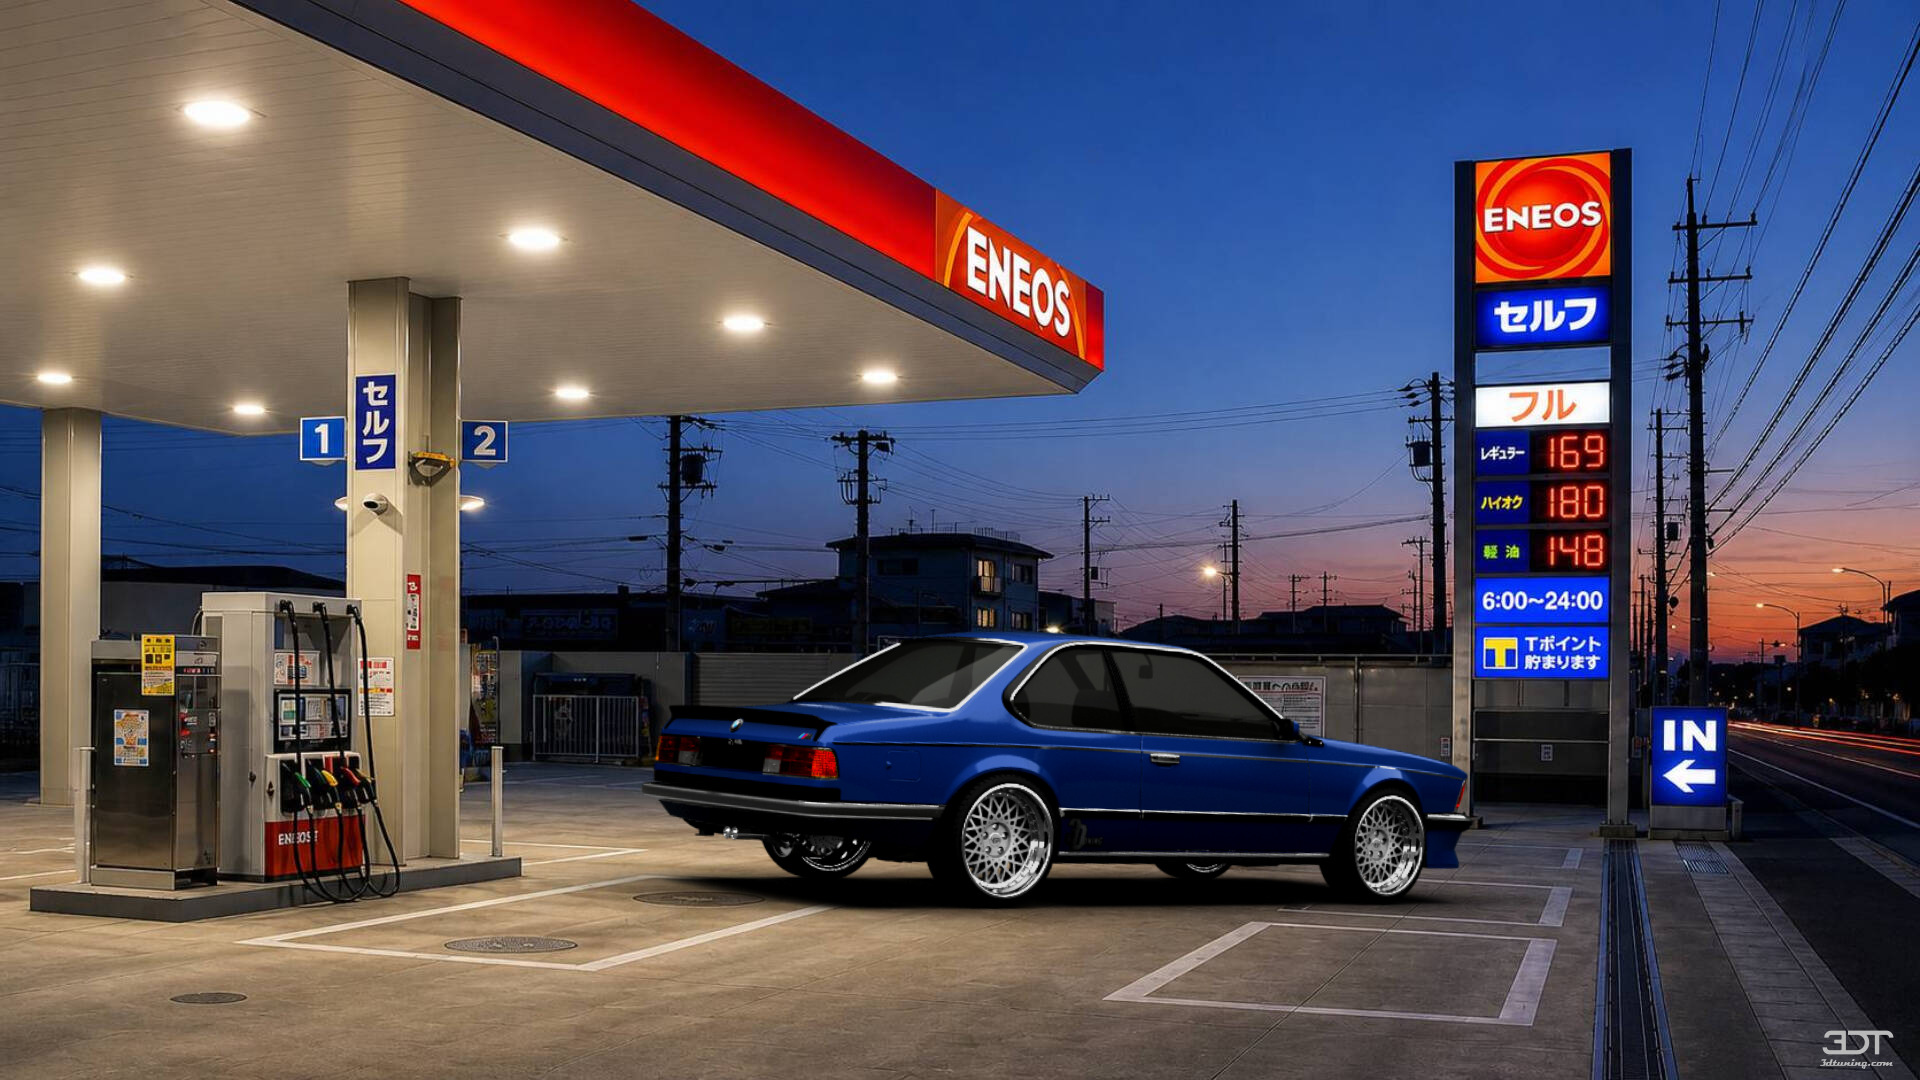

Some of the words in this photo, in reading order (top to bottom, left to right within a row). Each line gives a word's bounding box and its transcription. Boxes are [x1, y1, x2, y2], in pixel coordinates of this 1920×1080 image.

[1484, 201, 1602, 232] ENEOS
[967, 226, 1071, 337] ENEOS
[1494, 297, 1597, 333] セルフ
[1509, 389, 1577, 422] フル
[314, 423, 330, 454] 1
[362, 381, 389, 464] セルフ
[473, 425, 497, 456] 2
[1481, 446, 1525, 460] レギュラー
[1550, 435, 1604, 468] 169
[1481, 495, 1523, 510] ハイオク
[1550, 486, 1604, 518] 180
[1550, 535, 1604, 567] 148
[1524, 635, 1601, 652] Tポイント
[1524, 655, 1601, 670] 貯まります
[1663, 720, 1717, 751] IN
